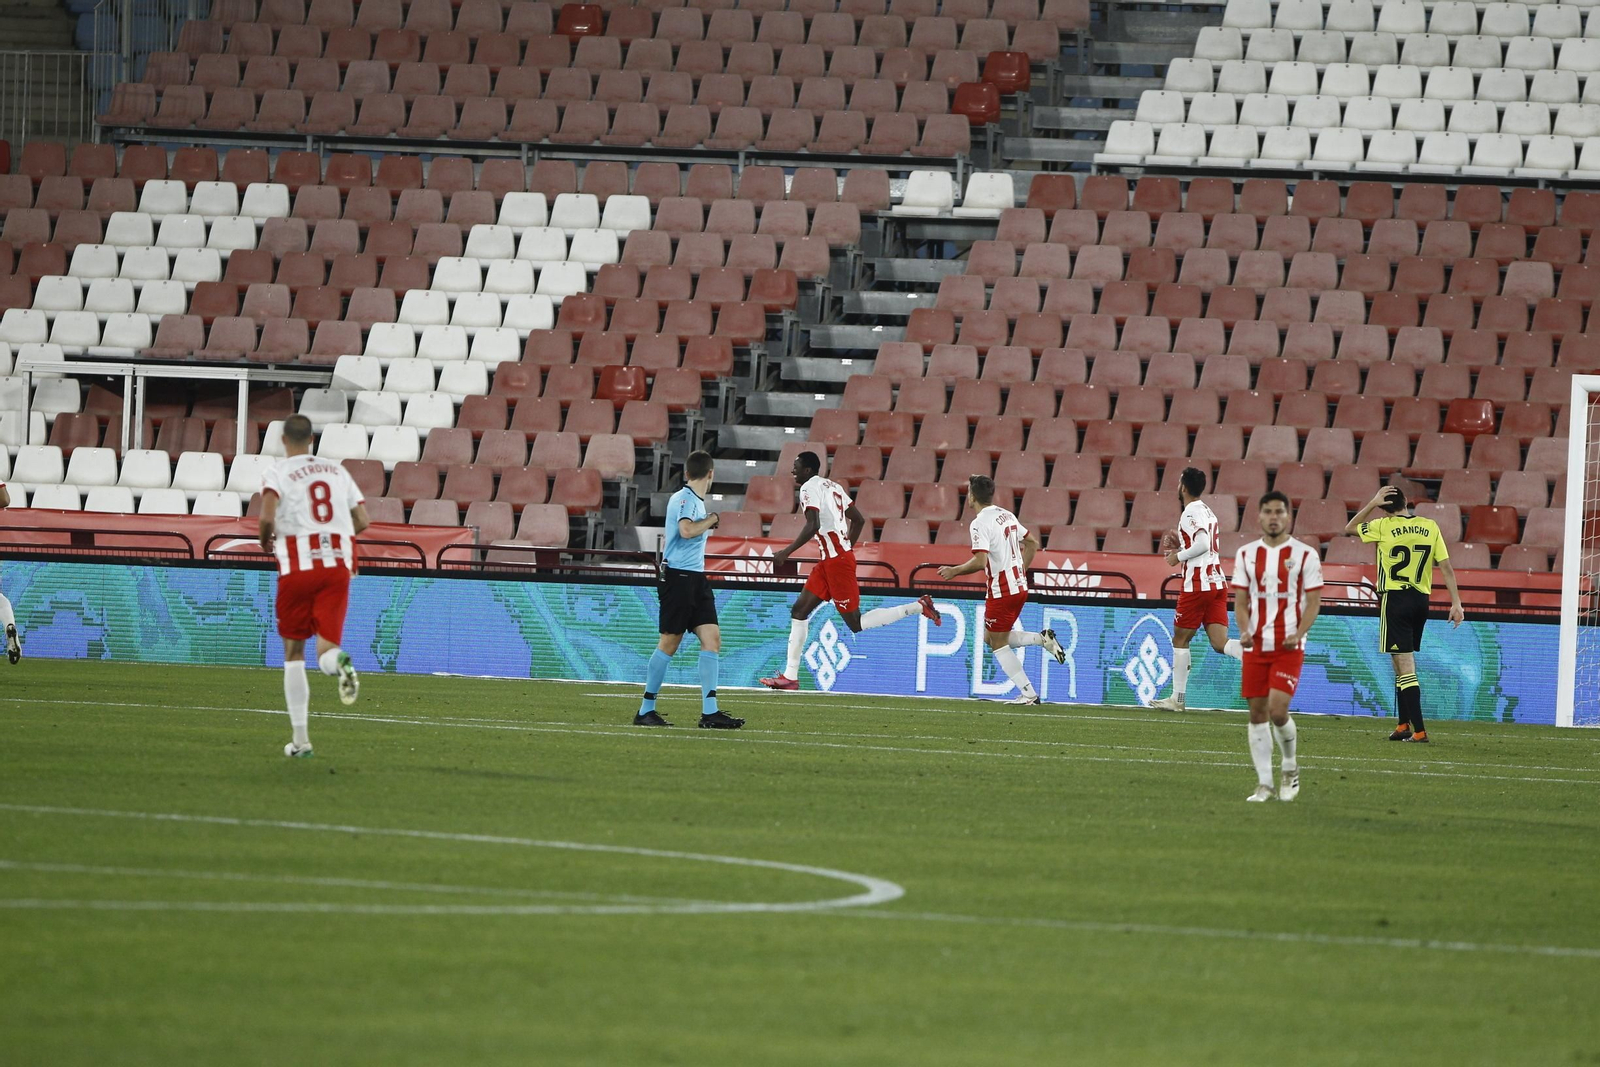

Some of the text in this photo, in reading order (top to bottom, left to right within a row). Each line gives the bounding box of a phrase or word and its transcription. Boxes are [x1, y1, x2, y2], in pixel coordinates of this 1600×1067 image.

[309, 480, 333, 523] 8
[833, 491, 844, 521] 9
[1391, 525, 1430, 538] FRANCHO
[1389, 544, 1432, 584] 27
